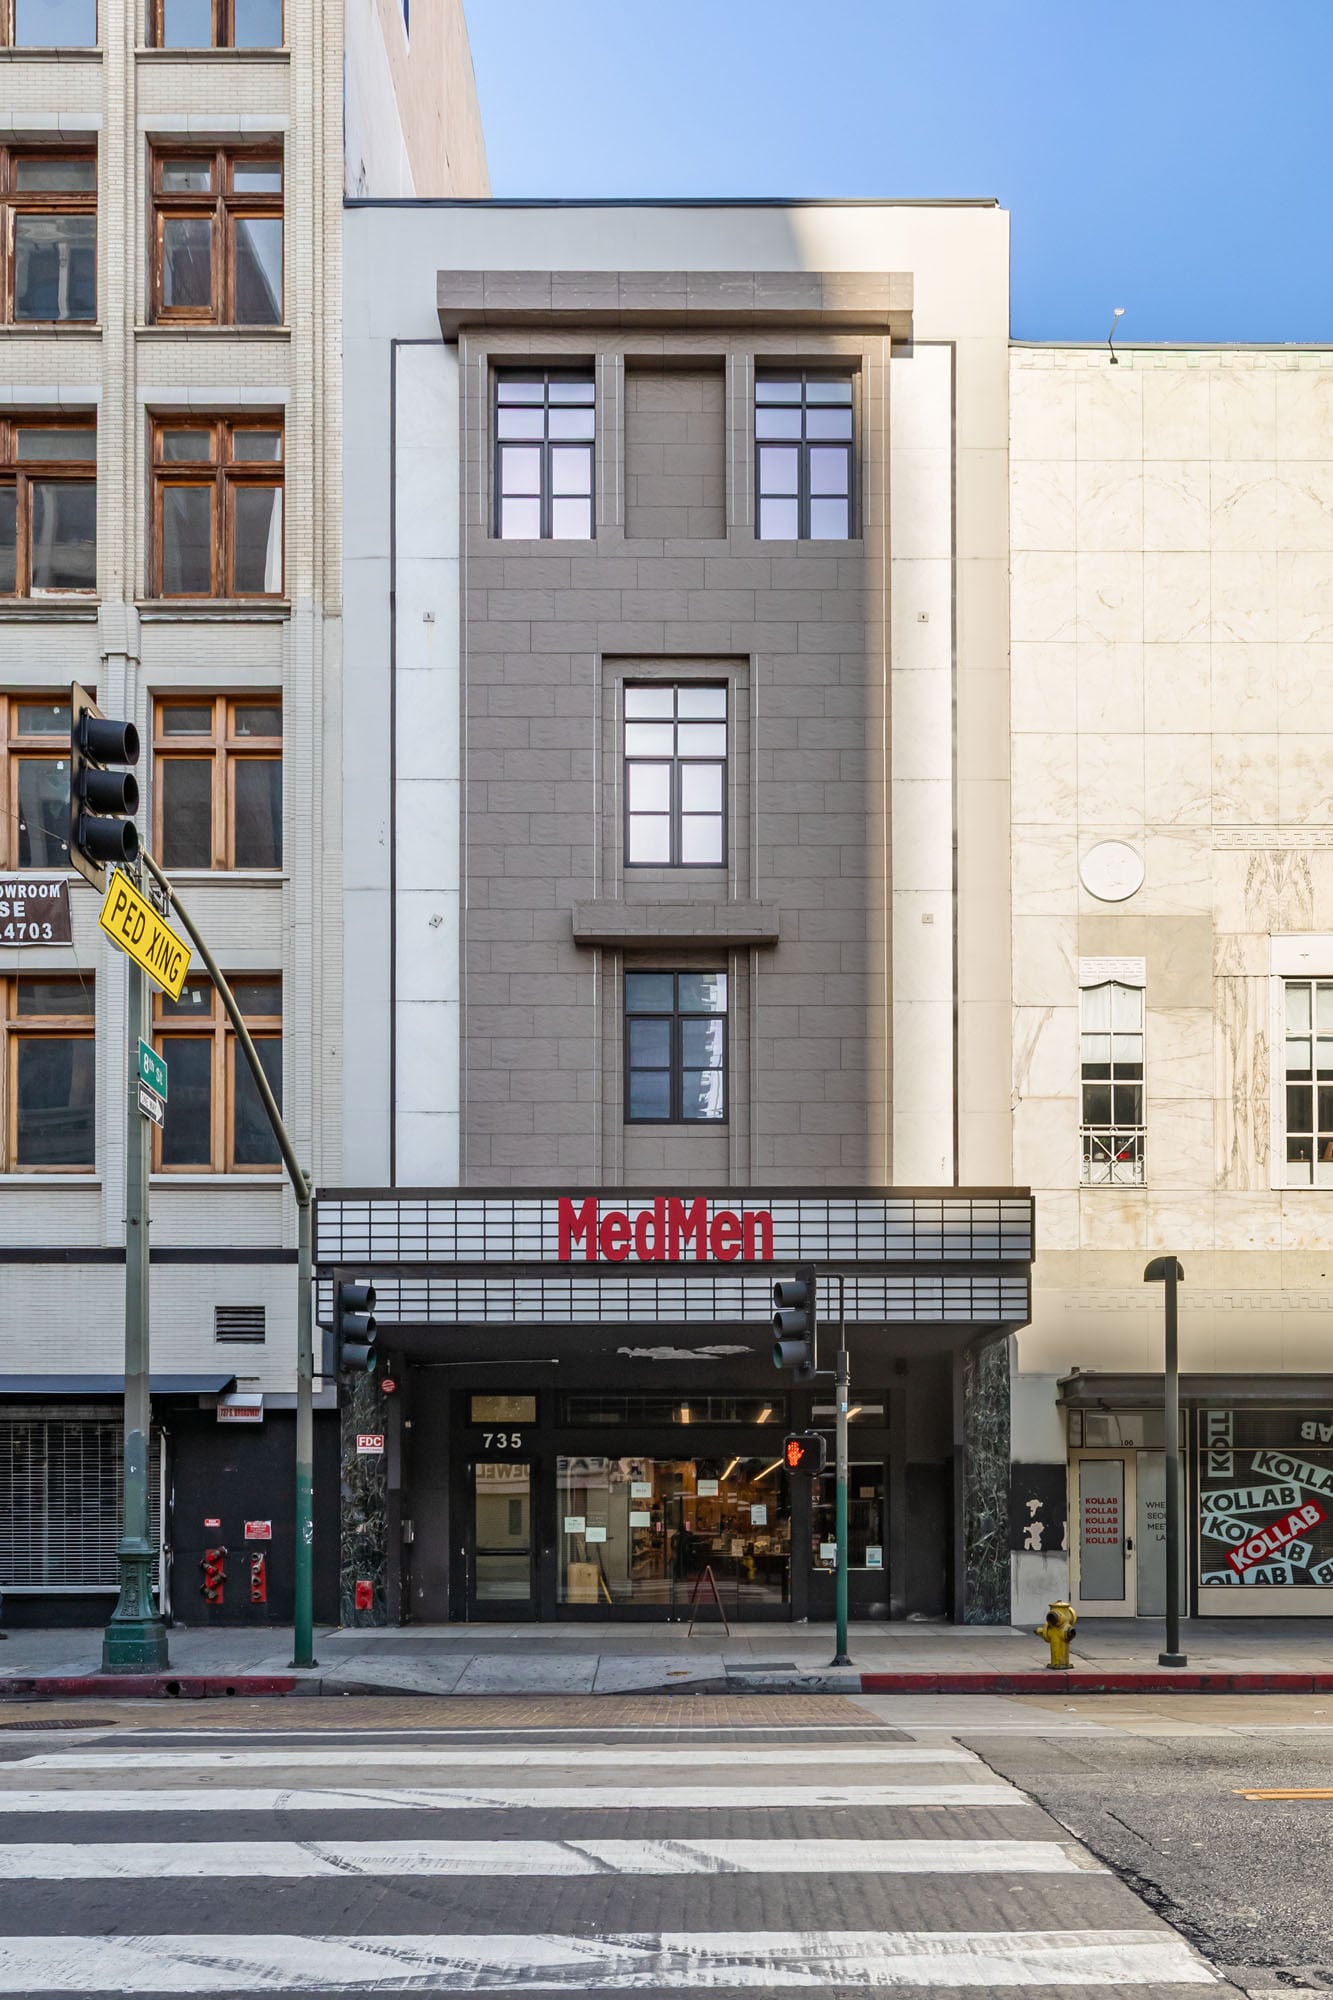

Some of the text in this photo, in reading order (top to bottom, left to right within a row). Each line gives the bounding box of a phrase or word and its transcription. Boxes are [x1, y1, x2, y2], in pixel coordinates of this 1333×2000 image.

[111, 889, 182, 983] PED XING
[143, 1052, 163, 1087] 8th St
[558, 1196, 774, 1262] MedMen
[358, 1436, 382, 1447] FDC
[482, 1432, 522, 1449] 735
[1201, 1486, 1296, 1514] KOLLAB
[1230, 1505, 1320, 1570] KOLLAB
